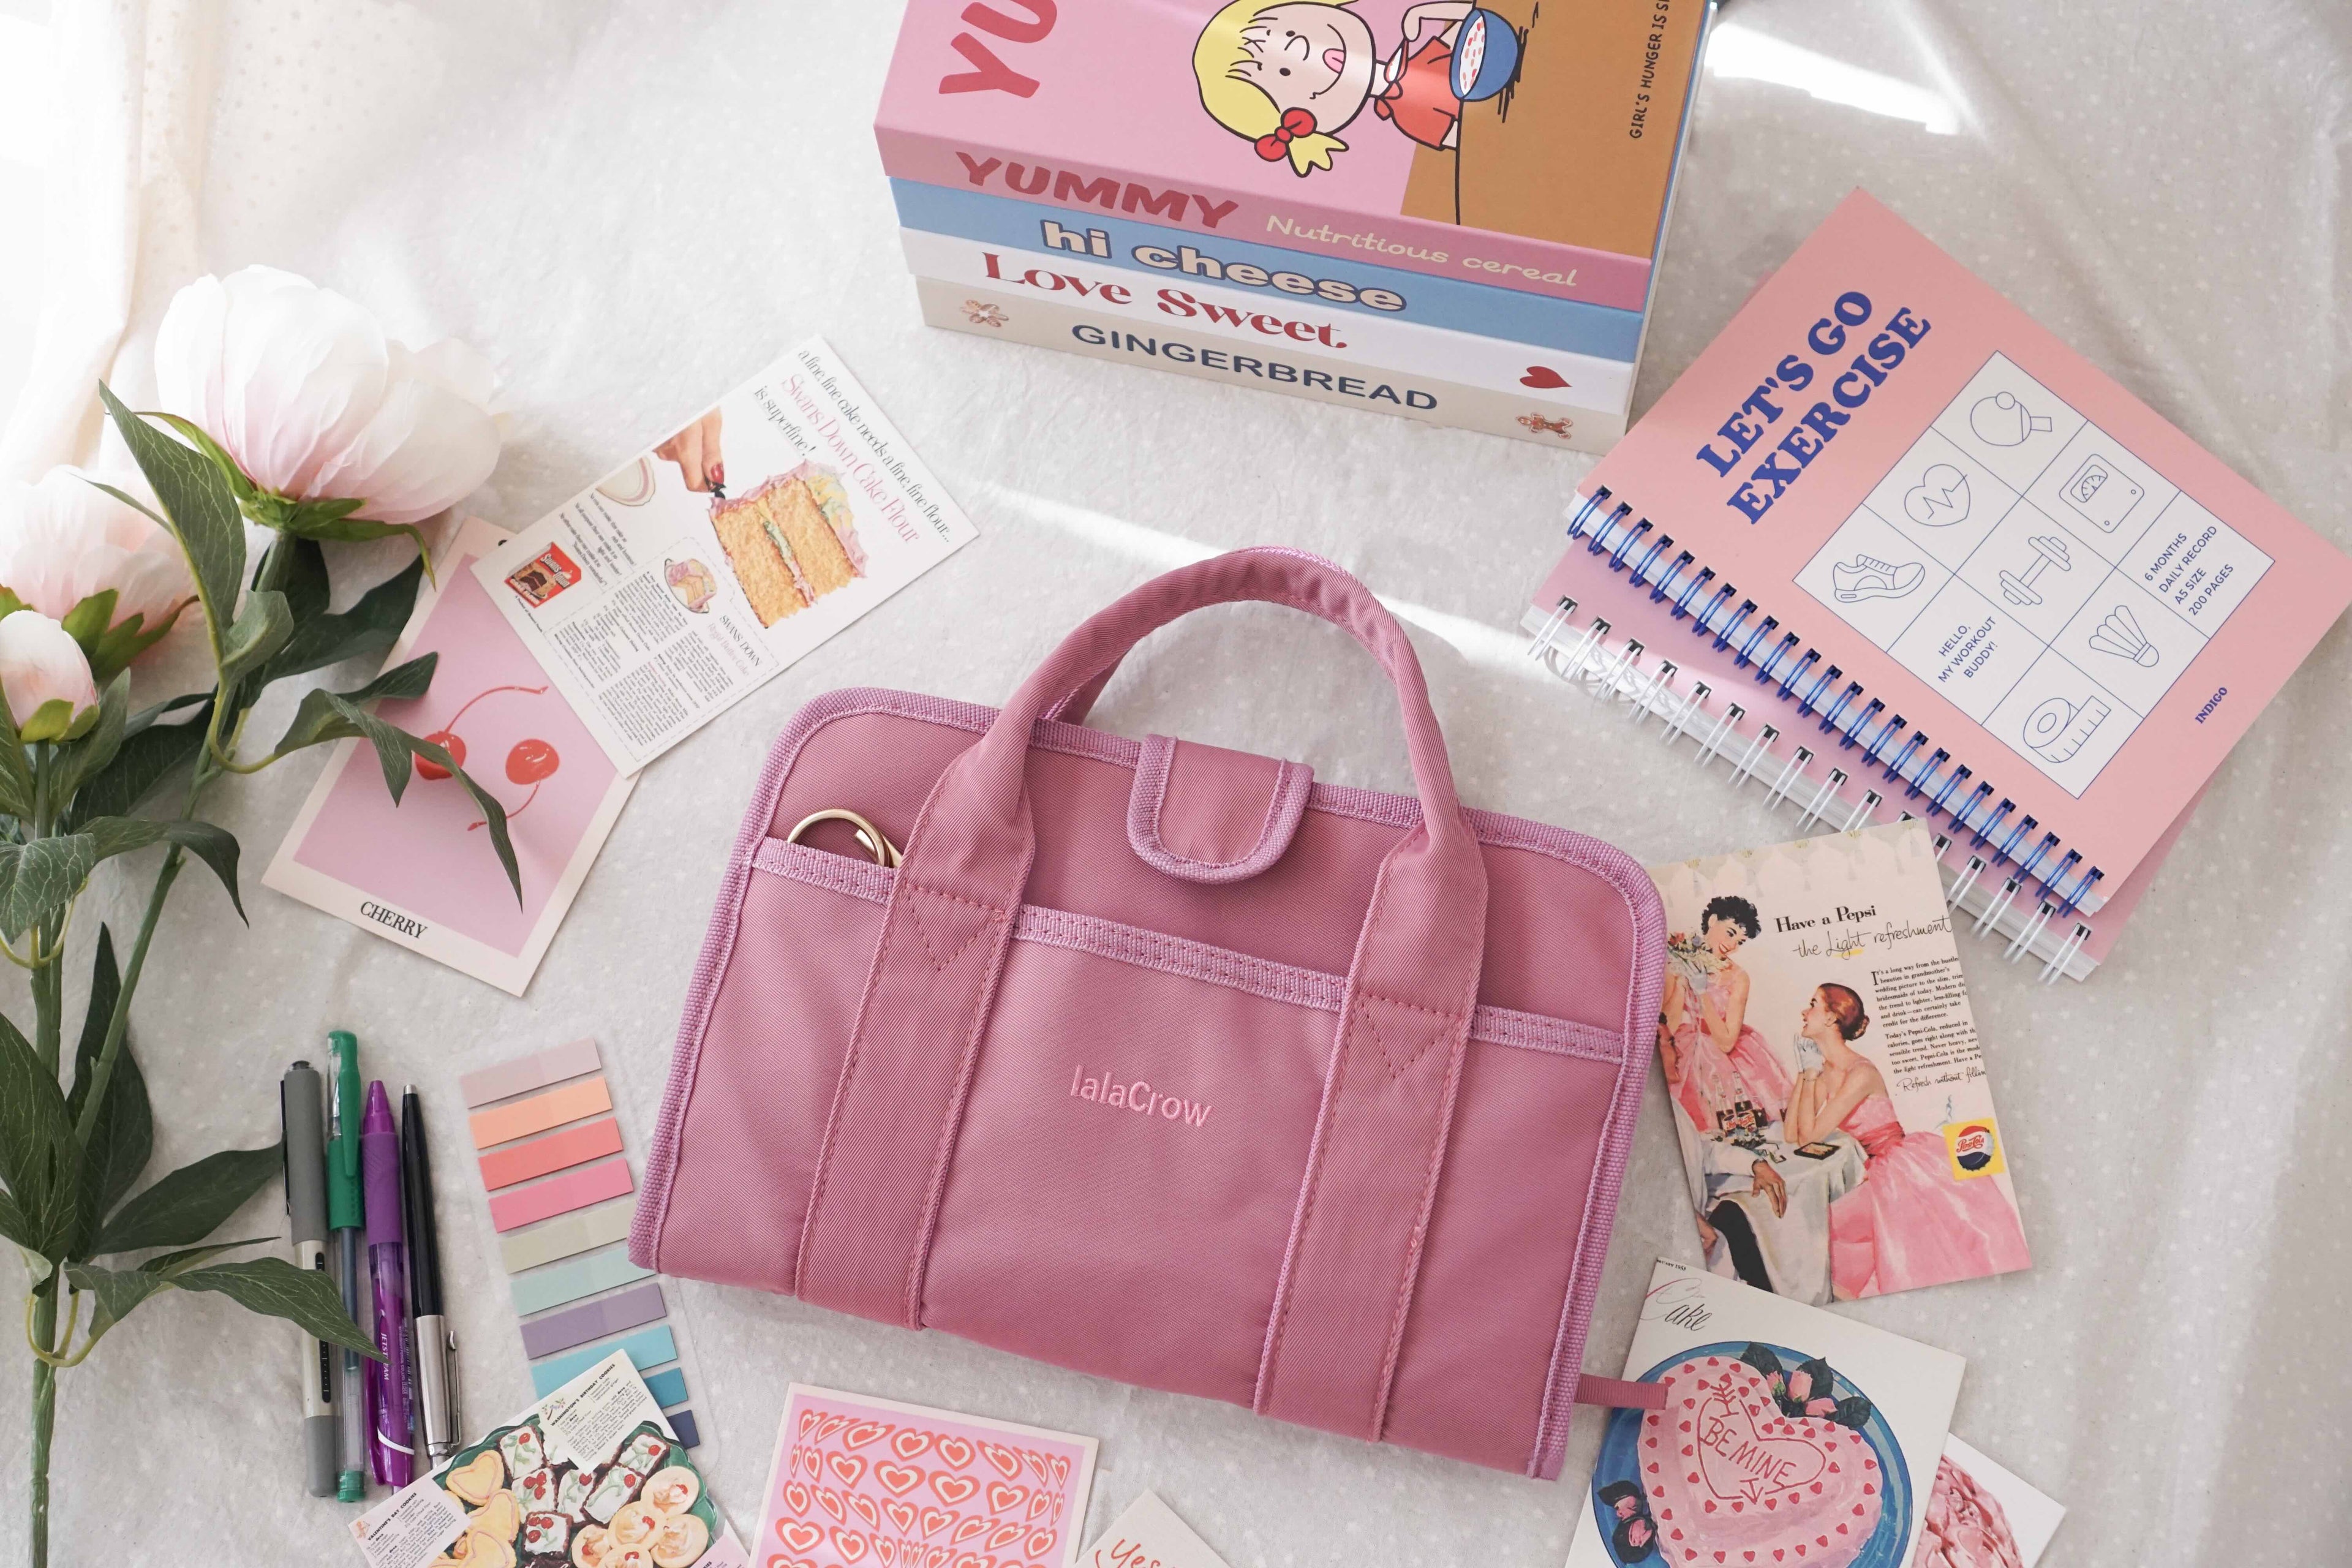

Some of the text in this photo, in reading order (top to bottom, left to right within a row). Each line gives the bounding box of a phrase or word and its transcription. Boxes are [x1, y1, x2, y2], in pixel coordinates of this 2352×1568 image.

[1629, 92, 1649, 138] GIRL'S
[1640, 33, 1662, 88] HUNGER
[1651, 13, 1667, 29] IS
[956, 151, 1238, 229] YUMMY
[1040, 219, 1407, 312] hi cheese
[1266, 215, 1578, 288] Nutritious cereal
[982, 252, 1348, 349] Love Sweet
[1072, 324, 1438, 410] GINGERBREAD
[1696, 291, 1872, 478] LET'S GO
[754, 385, 816, 456] is superfine!
[797, 349, 810, 364] a
[821, 376, 841, 398] fine
[837, 399, 860, 422] cake
[856, 423, 888, 457] needs
[881, 456, 894, 466] a
[906, 483, 927, 505] fine
[1727, 307, 1931, 525] EXERCISE
[781, 375, 918, 541] Swans Down Cake Flour
[2144, 532, 2187, 581] 6 MONTHS
[2158, 526, 2217, 593] DAILY RECORD
[2174, 567, 2206, 605] A5 SIZE
[2188, 564, 2233, 616] 200 PAGES
[1937, 616, 1996, 682] MY WORKOUT
[1938, 625, 1970, 657] HELLO,
[1963, 641, 1997, 678] BUDDY!
[2195, 687, 2227, 724] INDIGO
[360, 901, 428, 939] CHERRY
[1775, 905, 1876, 932] Have a Pepsi
[1792, 914, 1952, 960] the Light refreshment
[1911, 966, 1950, 979] grandmother's
[1940, 956, 1959, 964] bustle
[1875, 991, 1908, 1002] bridesmaids
[1898, 982, 1917, 991] picture
[1923, 1002, 1947, 1011] certainly
[1884, 1031, 1906, 1039] Today's
[1939, 1020, 1961, 1030] reduced
[1070, 1064, 1213, 1128] lalaCrow
[1896, 1076, 1931, 1091] Refresh
[1934, 1072, 1961, 1084] without
[380, 1332, 390, 1380] JETSTEAM
[546, 1398, 579, 1426] WASHINGTON'S
[579, 1379, 598, 1398] BIRTHDAY
[598, 1363, 615, 1379] COOKIES
[1701, 1416, 1796, 1491] BE MINE
[367, 1517, 391, 1540] VALENTINE'S
[390, 1509, 399, 1518] DAY
[400, 1492, 417, 1509] COOKIES
